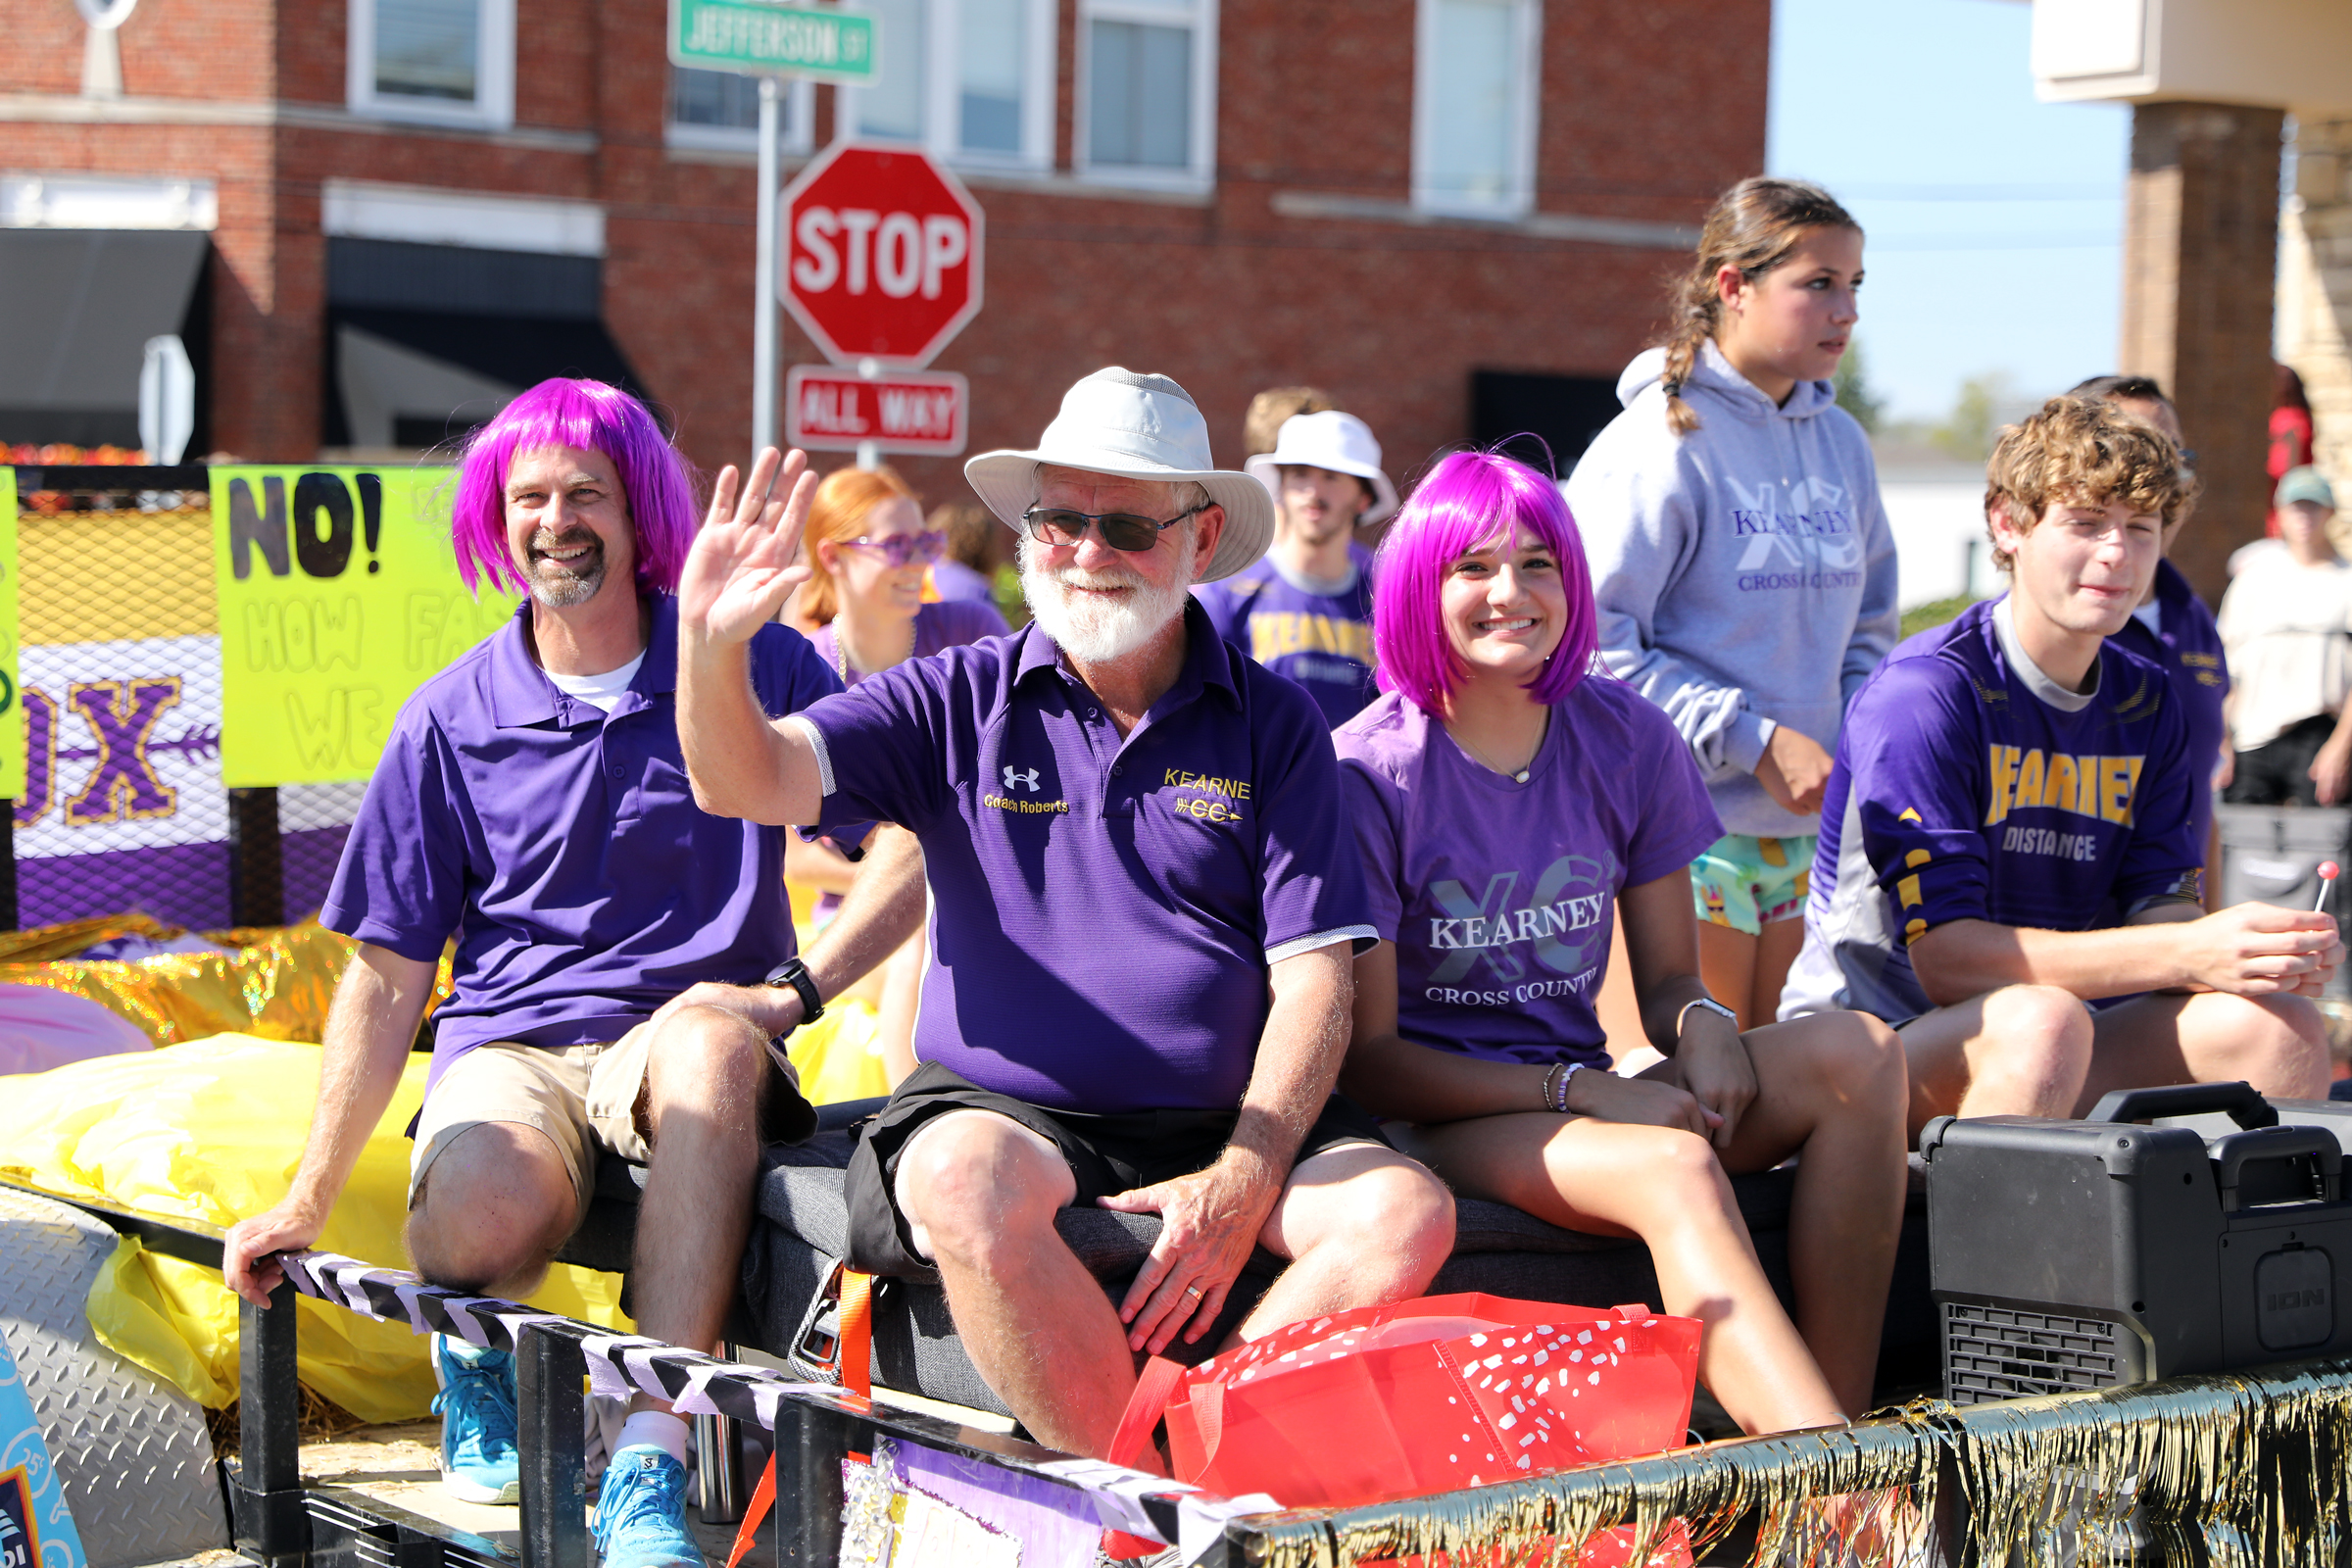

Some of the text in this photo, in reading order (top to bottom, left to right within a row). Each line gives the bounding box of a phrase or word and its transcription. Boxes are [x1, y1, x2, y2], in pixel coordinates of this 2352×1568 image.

[684, 5, 840, 66] JEFFERSON
[792, 205, 968, 301] STOP
[800, 383, 958, 439] ALL WAY
[227, 471, 384, 582] NO!
[1738, 572, 1799, 591] CROSS
[242, 590, 366, 673] HOW
[983, 794, 1069, 815] Coach Roberts
[2001, 826, 2097, 861] DISTANCE
[1428, 891, 1605, 950] KEARNEY
[1425, 987, 1510, 1006] CROSS
[2267, 1288, 2325, 1312] ION
